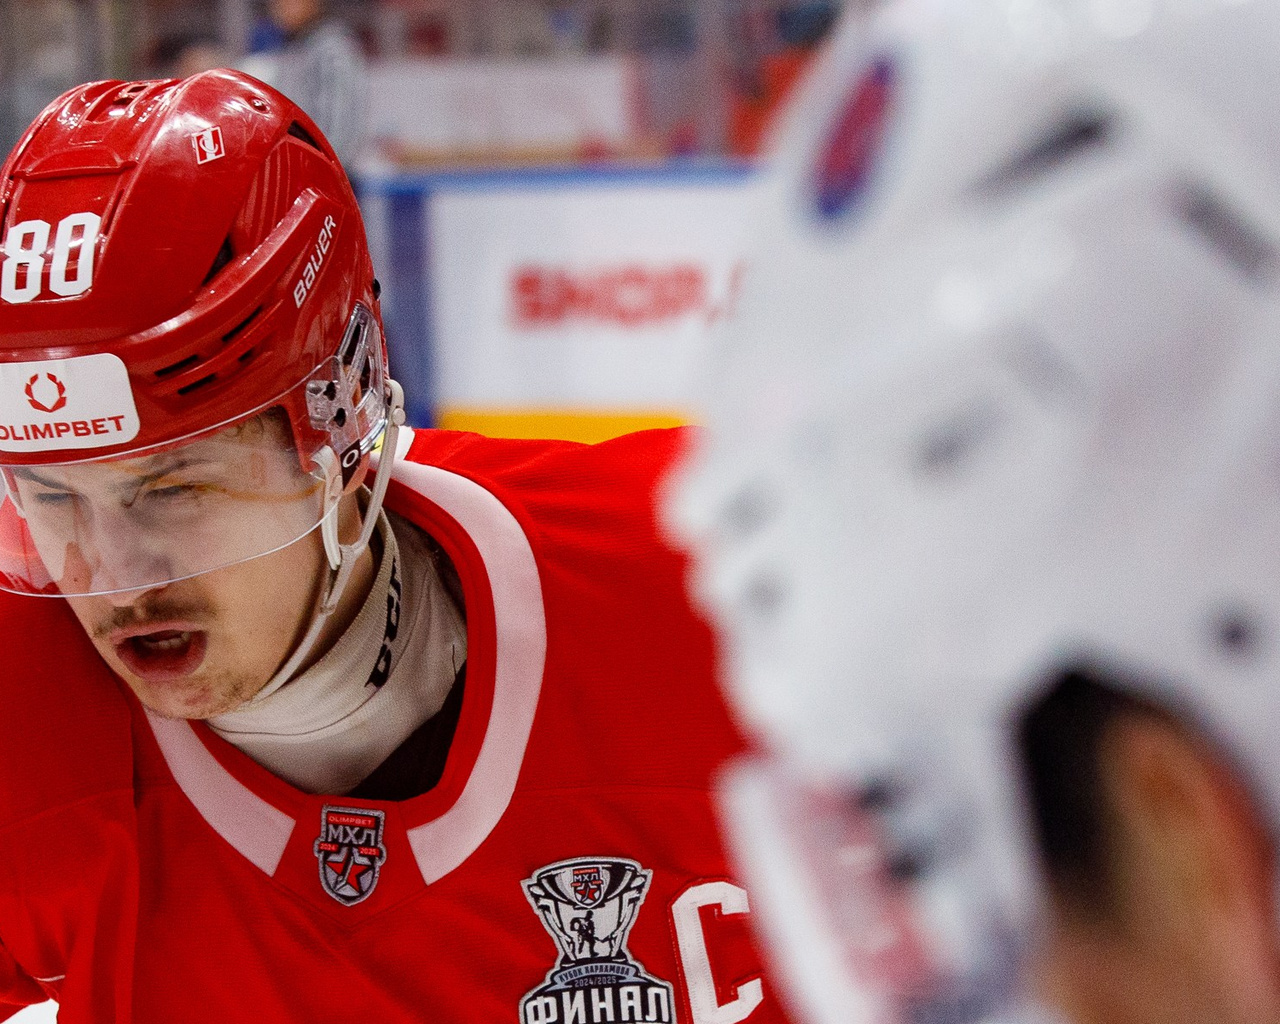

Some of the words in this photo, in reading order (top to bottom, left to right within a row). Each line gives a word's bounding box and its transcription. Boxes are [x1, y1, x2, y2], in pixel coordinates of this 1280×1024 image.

[0, 211, 101, 303] 80
[328, 815, 372, 826] OLIMPBET
[327, 824, 376, 846] МХЛ
[573, 873, 599, 882] МХЛ
[558, 966, 583, 983] КУБОК
[584, 964, 631, 976] ХАРЛАМОВА
[574, 976, 617, 988] 2024/2025
